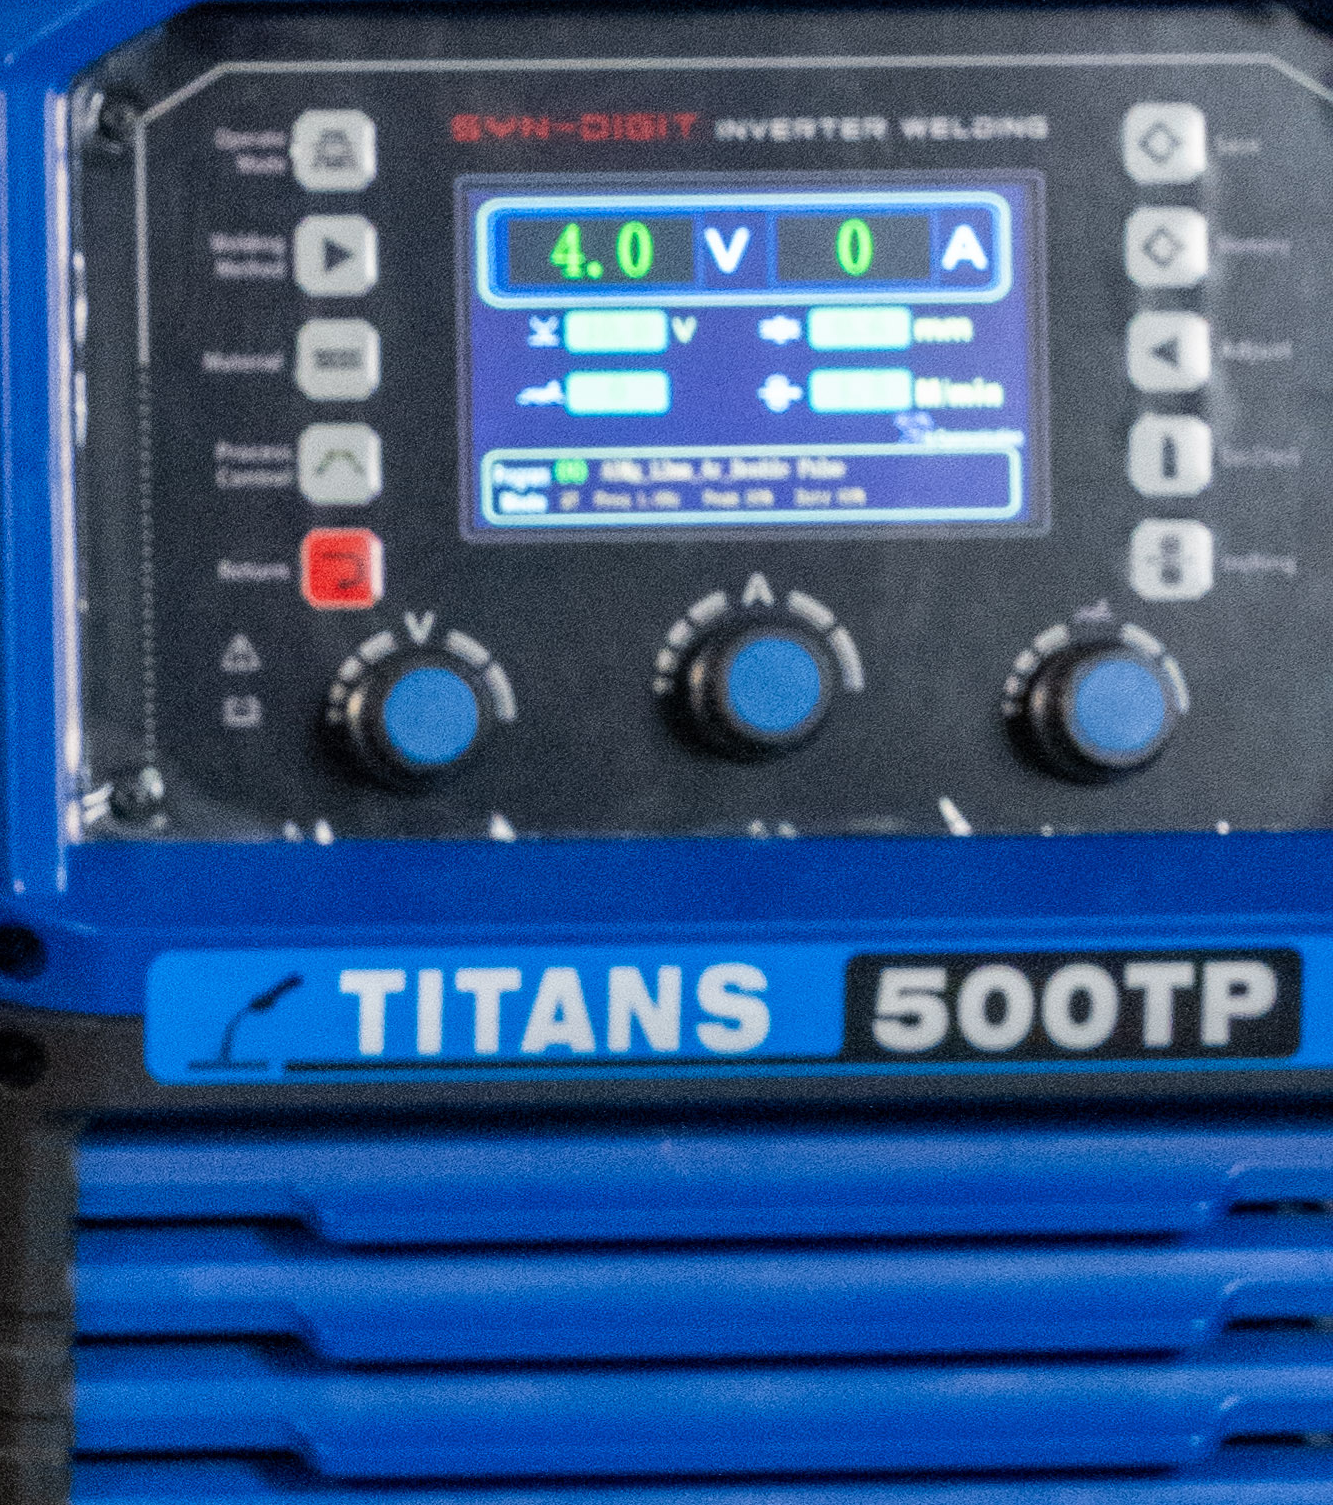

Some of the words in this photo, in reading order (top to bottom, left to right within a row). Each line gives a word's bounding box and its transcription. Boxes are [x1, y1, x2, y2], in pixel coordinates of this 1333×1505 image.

[714, 115, 888, 142] INVERTER
[900, 113, 1050, 141] WELDING
[549, 219, 655, 280] 4.0
[703, 225, 751, 274] V
[834, 217, 874, 277] 0
[940, 223, 989, 271] A
[741, 572, 775, 606] A
[404, 609, 436, 645] V
[339, 962, 773, 1057] TITANS
[870, 960, 1279, 1053] 500TP
